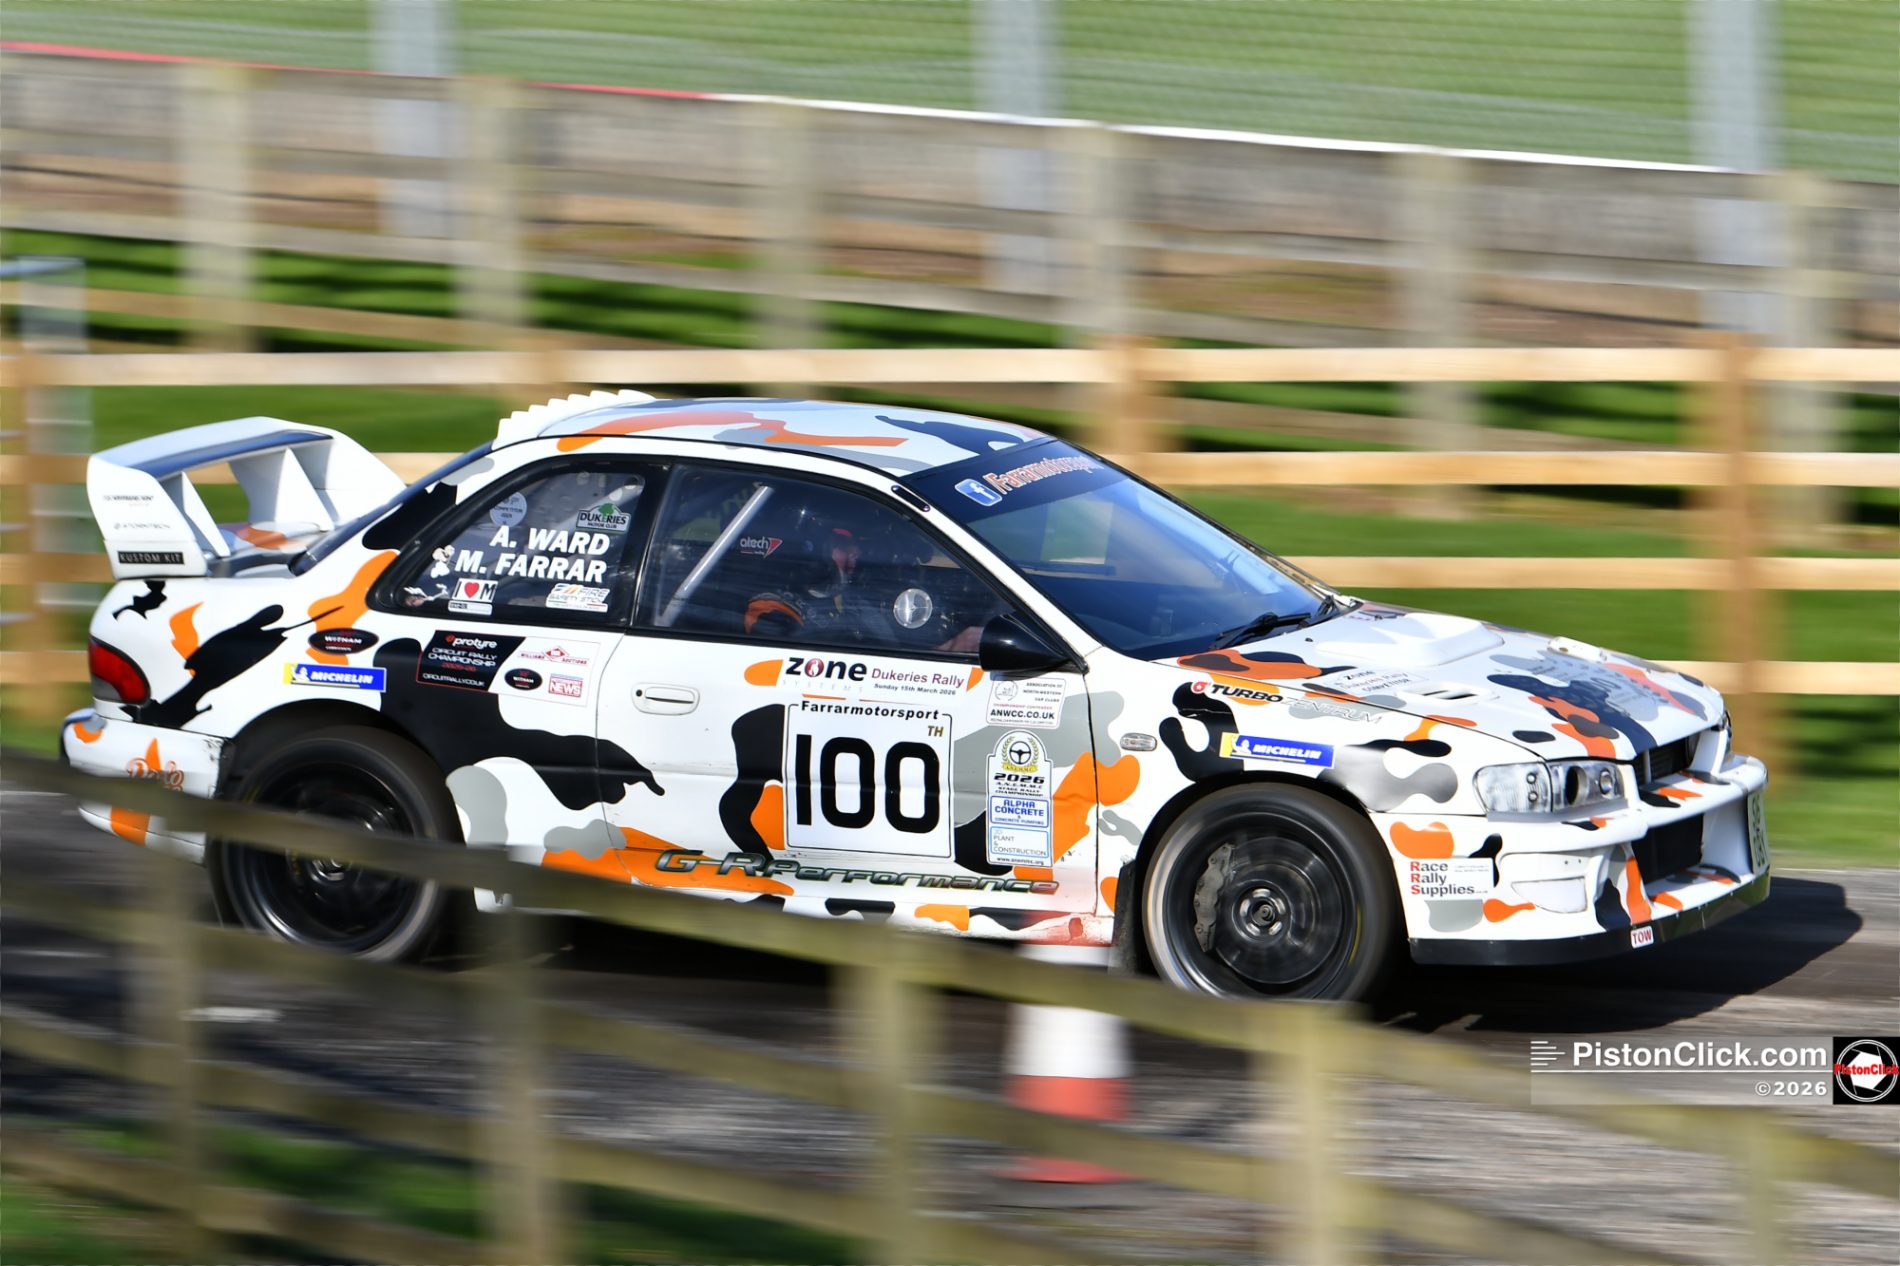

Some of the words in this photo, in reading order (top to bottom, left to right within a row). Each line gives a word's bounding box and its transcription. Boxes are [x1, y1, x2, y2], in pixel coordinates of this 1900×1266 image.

[490, 525, 517, 548] A.
[528, 527, 610, 555] WARD
[119, 552, 160, 562] KUSTOM
[164, 553, 181, 562] KIT
[454, 549, 487, 574] M.
[494, 552, 608, 583] FARRAR
[480, 583, 497, 601] M
[452, 638, 498, 650] protyre
[428, 652, 496, 667] CHAMPIONSHIP
[432, 647, 468, 656] CIRCUIT
[468, 652, 498, 661] RALLY
[785, 656, 868, 682] zone
[310, 671, 374, 684] MICHELIN
[871, 668, 928, 683] Dukeries
[931, 673, 965, 688] Rally
[550, 681, 582, 695] NEWS
[874, 683, 898, 691] Sunday
[916, 686, 938, 694] March
[1211, 684, 1283, 703] TURBO
[801, 700, 939, 720] Farrarmotorsport
[990, 709, 1055, 719] ANWCC.CO.UK
[927, 725, 944, 738] TH
[1253, 743, 1322, 760] MICHELIN
[795, 733, 941, 835] 100
[994, 772, 1045, 784] 2026
[1003, 799, 1036, 808] ALPHA
[994, 805, 1044, 817] CONCRETE
[993, 847, 1046, 856] CONSTRUCTION
[1410, 861, 1448, 872] Race
[1411, 873, 1447, 886] Rally
[1632, 930, 1653, 945] TOW
